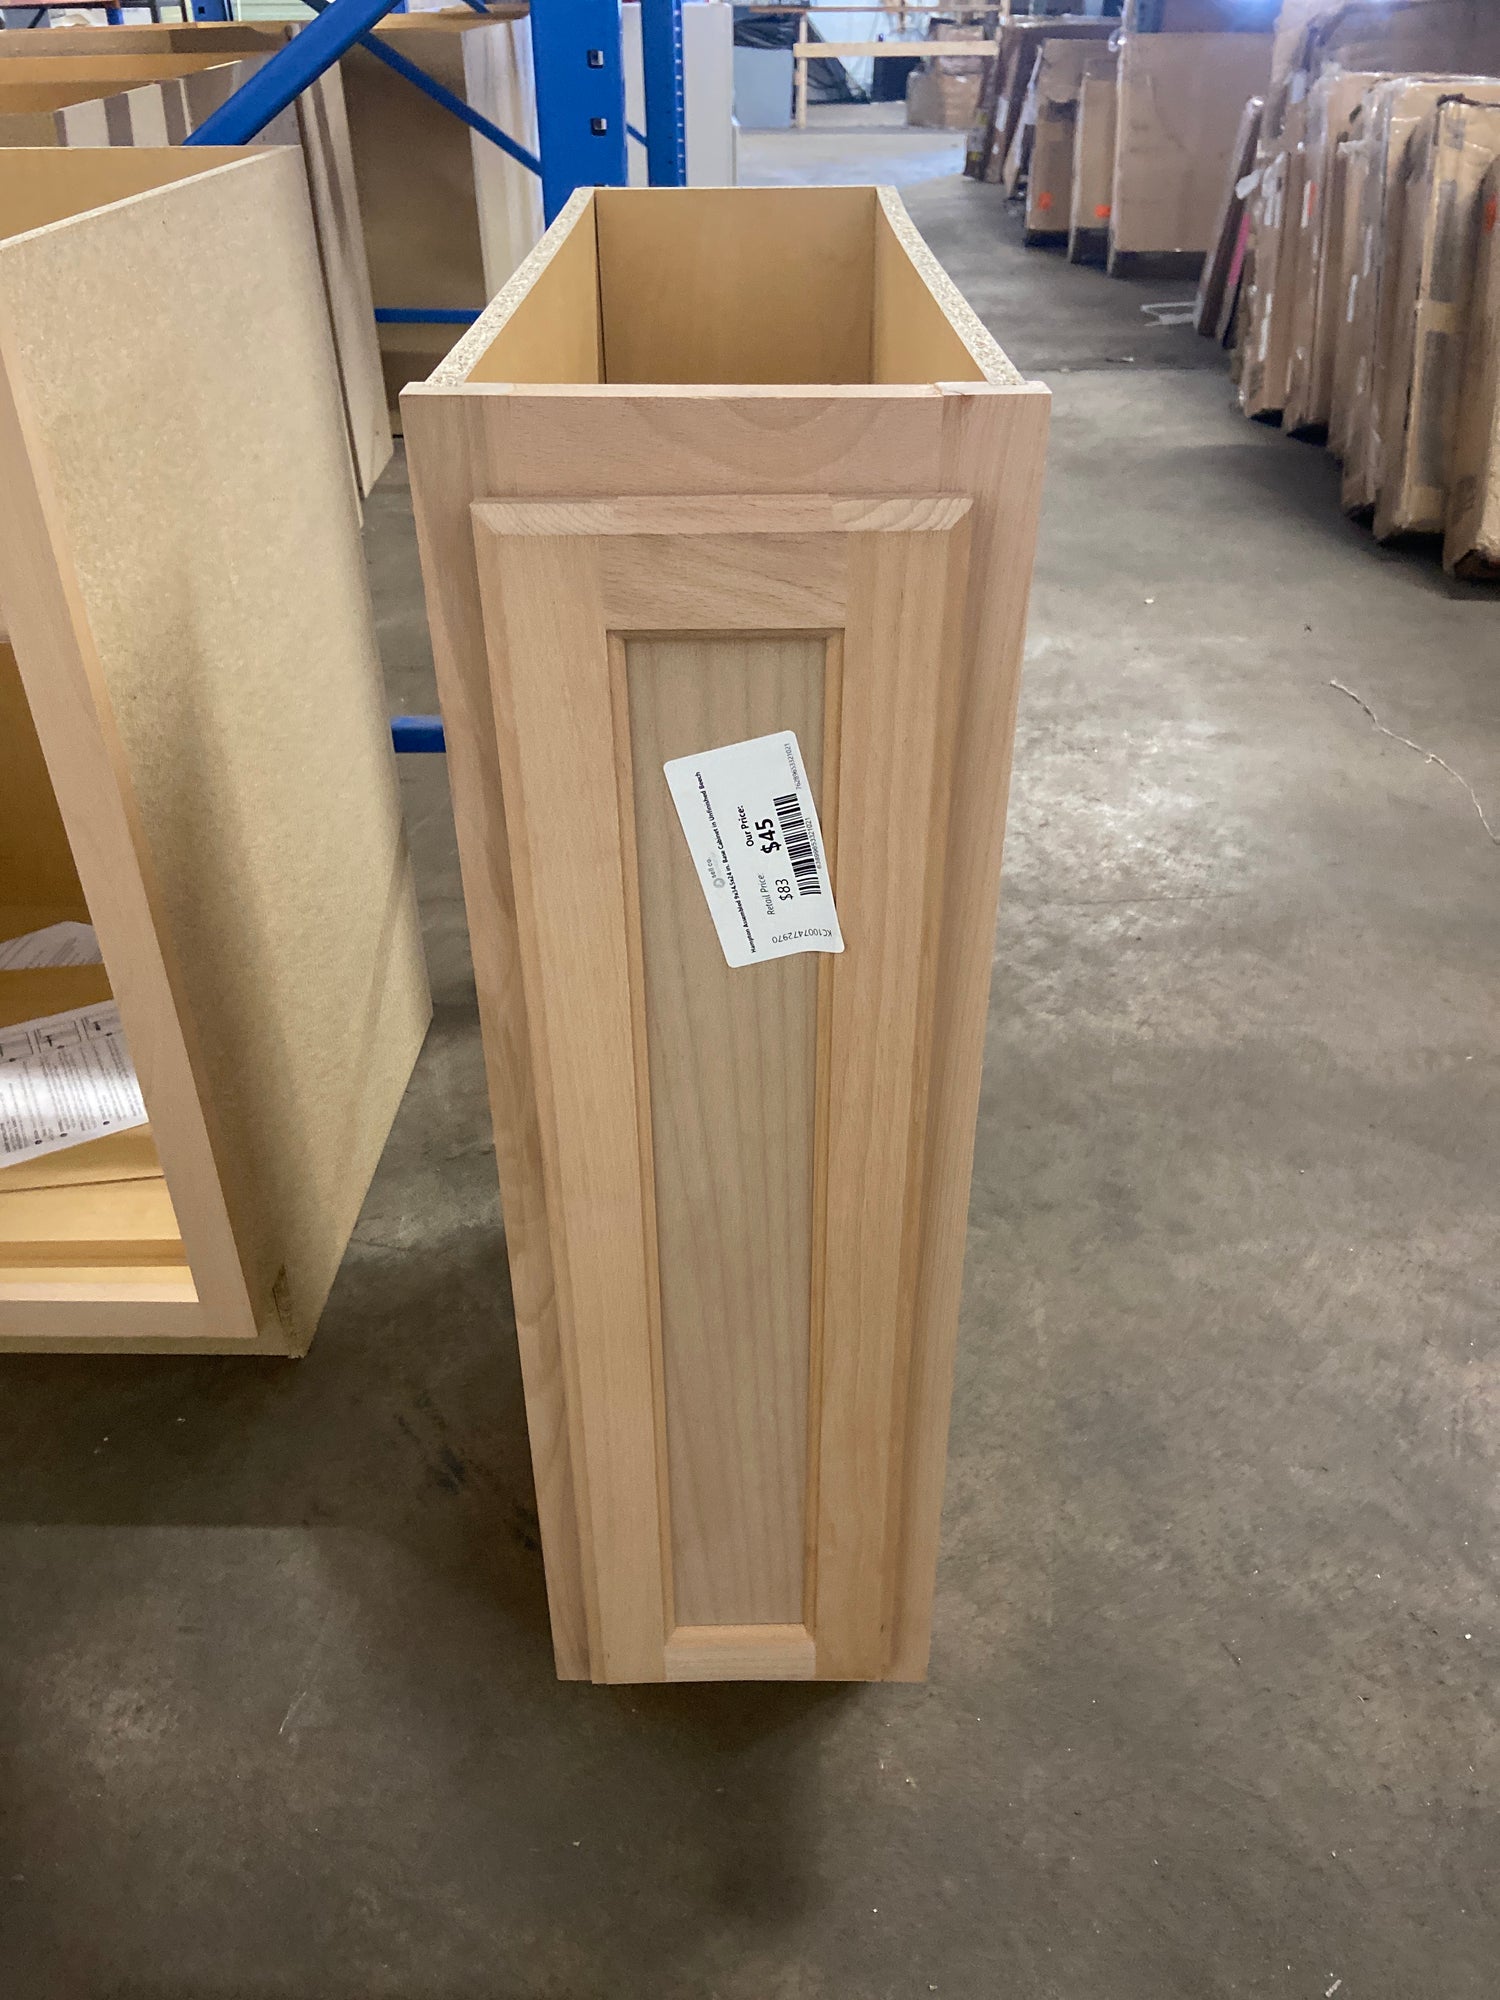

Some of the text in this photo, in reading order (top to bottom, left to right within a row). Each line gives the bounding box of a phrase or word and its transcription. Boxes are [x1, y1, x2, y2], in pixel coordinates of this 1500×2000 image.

[695, 771, 705, 790] Beech
[700, 790, 715, 821] Unfinished
[737, 805, 754, 847] Our Price:
[754, 818, 782, 854] $45
[713, 828, 724, 850] Cabinet
[775, 878, 794, 901] $83
[735, 900, 749, 928] Assembled
[761, 894, 775, 915] Retail
[745, 928, 756, 953] Hampton
[771, 928, 832, 944] KC1007472970
